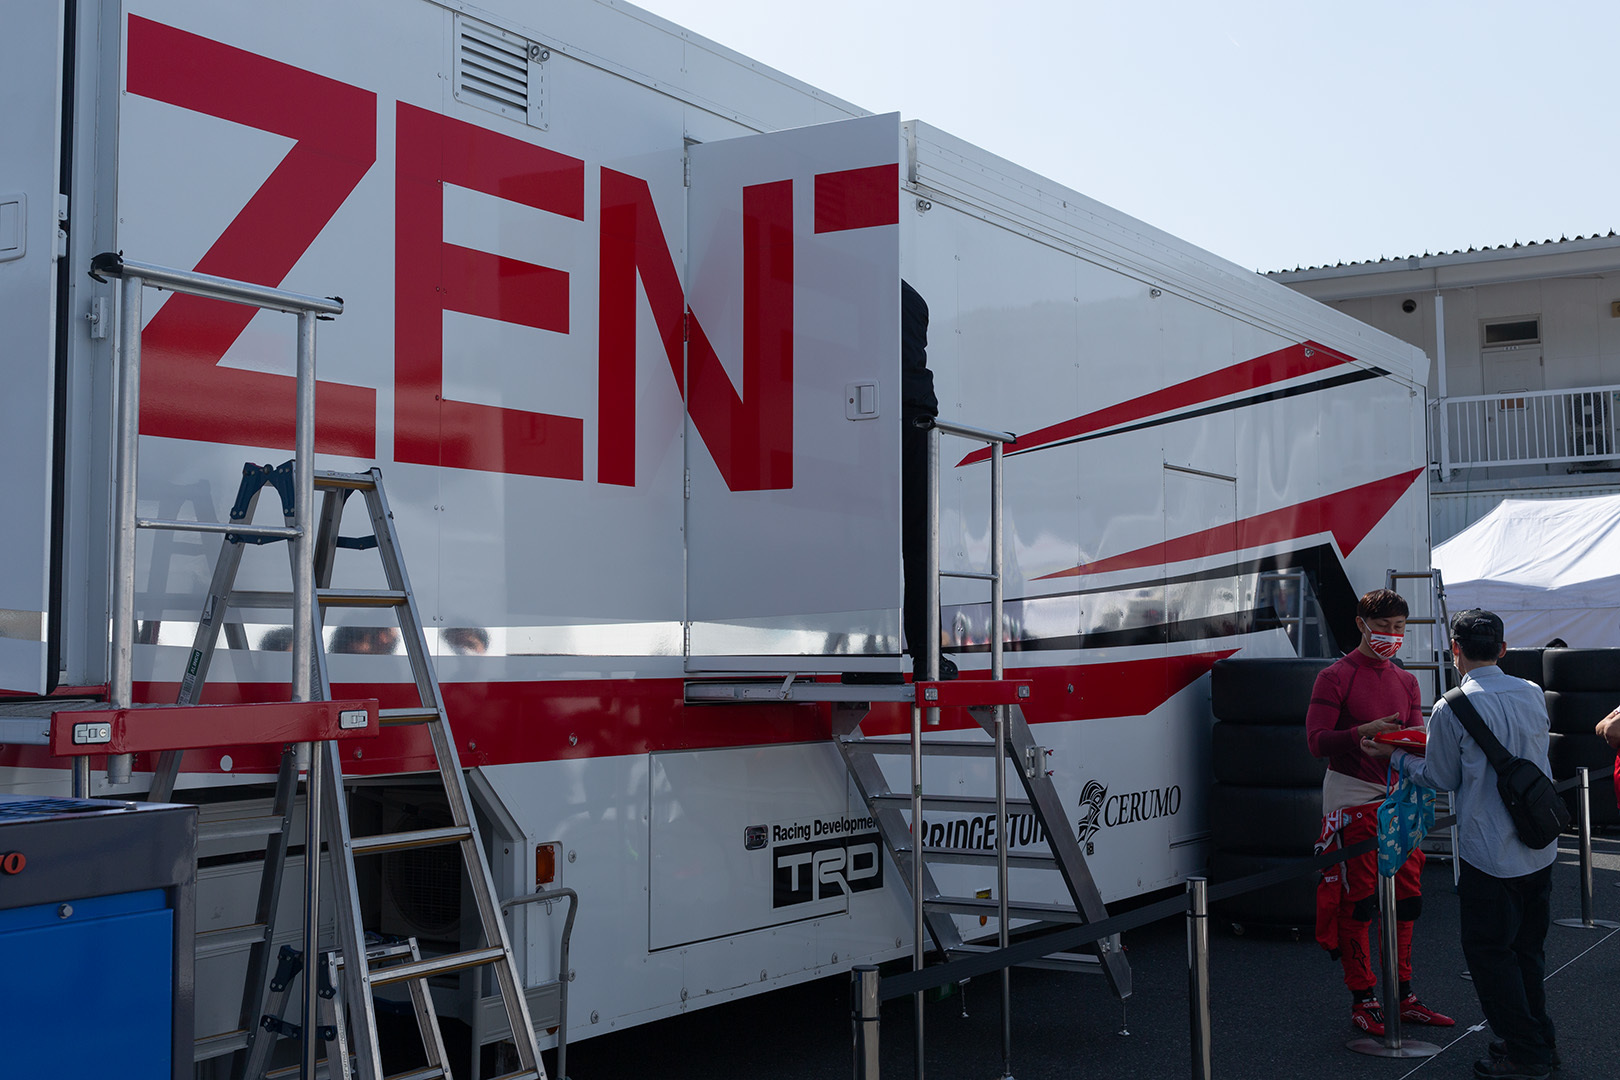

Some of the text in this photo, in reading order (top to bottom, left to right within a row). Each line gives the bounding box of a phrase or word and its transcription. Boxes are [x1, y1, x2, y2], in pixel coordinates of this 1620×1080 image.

[127, 13, 899, 492] ZEN
[1104, 785, 1181, 827] CERUMO
[773, 822, 811, 841] Racing
[777, 842, 879, 900] TRD
